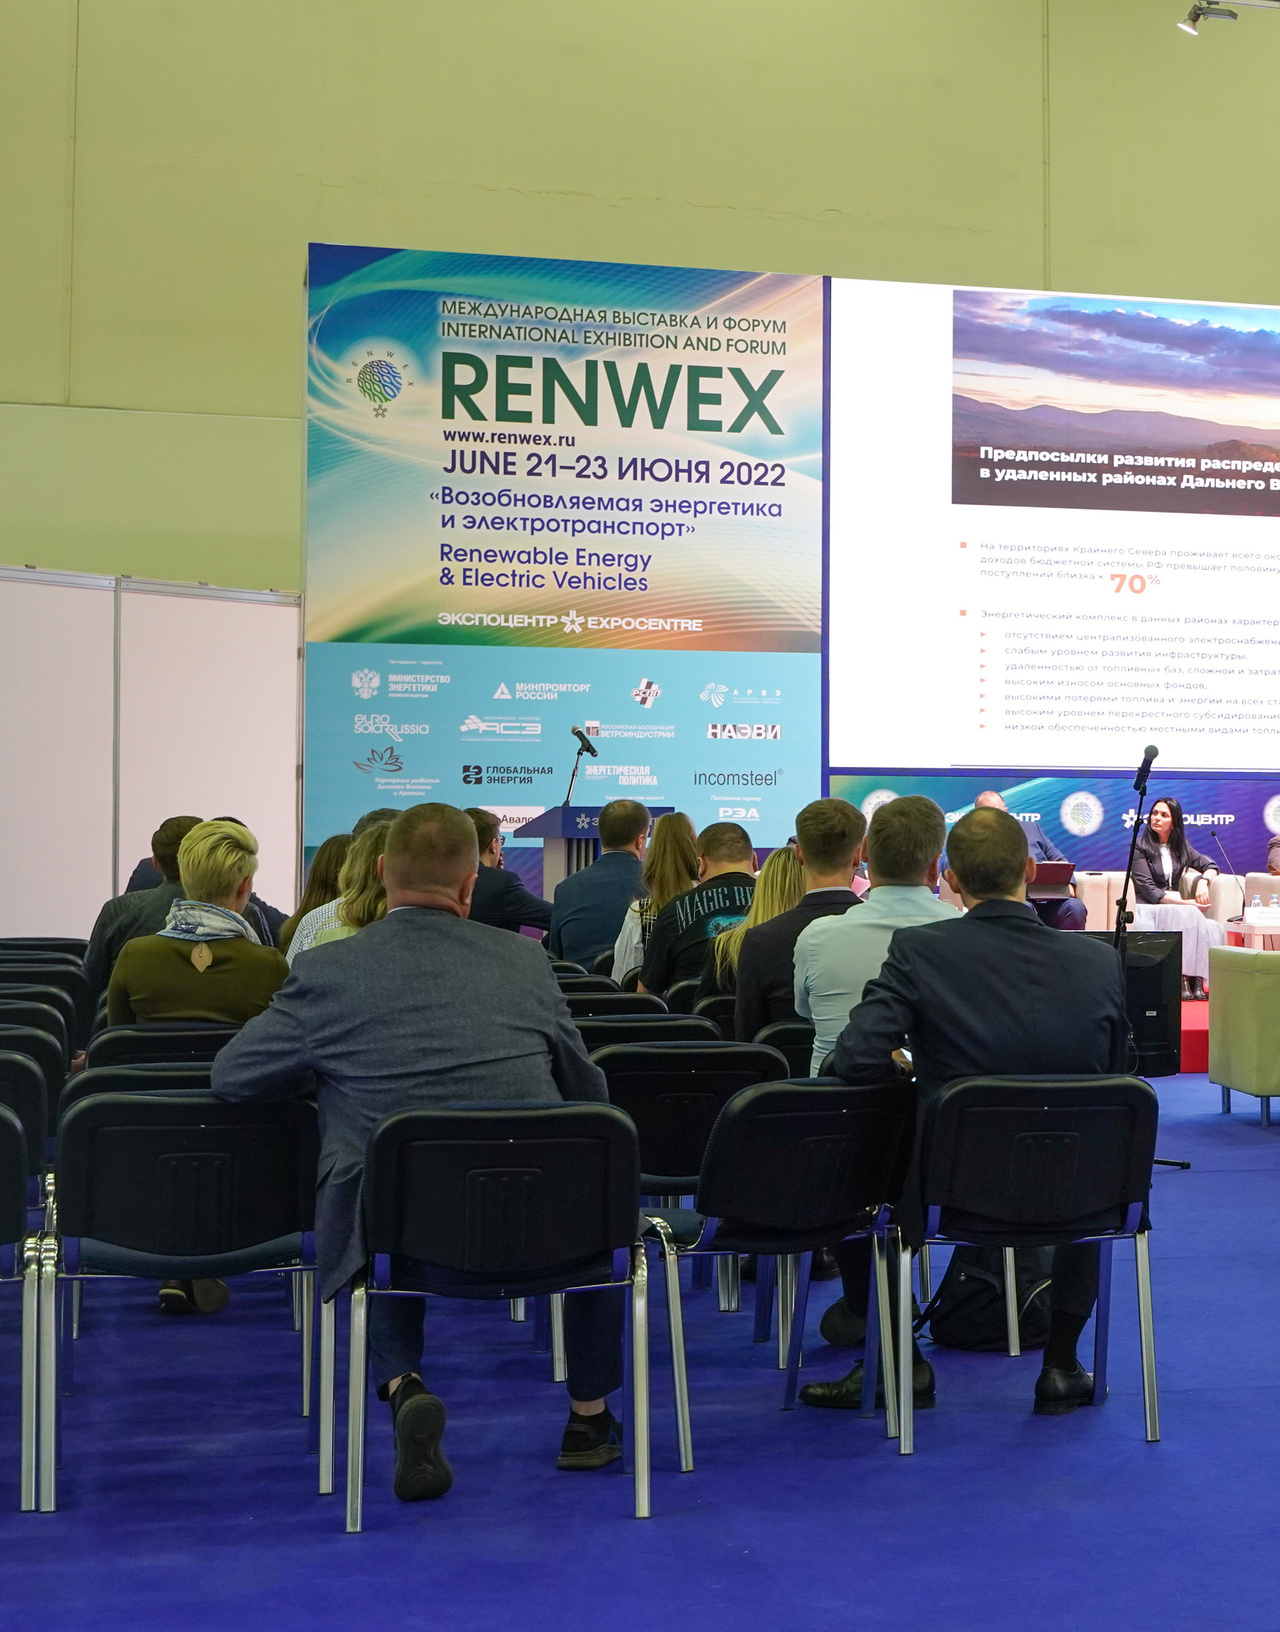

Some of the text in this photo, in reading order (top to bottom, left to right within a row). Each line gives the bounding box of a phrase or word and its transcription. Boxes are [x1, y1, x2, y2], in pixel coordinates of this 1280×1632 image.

[442, 300, 786, 334] МЕЖДУНАРОДНАЯ ВЫСТАВКА И ФОРУМ
[442, 322, 786, 355] INTERNATIONAL EXHIBITION AND FORUM
[441, 351, 785, 435] RENWEX
[442, 430, 576, 447] www.renwex.ru
[980, 446, 1108, 464] Предпосылки
[1113, 454, 1196, 470] развития
[442, 449, 517, 475] JUNE
[618, 457, 710, 483] ИЮНЯ
[719, 461, 786, 486] 2022
[980, 467, 991, 478] в
[994, 468, 1098, 482] удаленных
[1102, 471, 1177, 486] районах
[1180, 474, 1266, 489] Дальнего
[649, 499, 782, 517] энергетика
[441, 514, 455, 528] и
[440, 543, 652, 572] Renewable Energy
[998, 544, 1069, 552] территориях
[1073, 546, 1125, 554] Крайнего
[1128, 547, 1167, 556] Севера
[1170, 550, 1229, 558] проживает
[439, 567, 648, 591] & Electric Vehicles
[1110, 574, 1160, 594] 70%
[437, 612, 703, 632] ЭКСПОЦЕНТР EXPOCENTRE
[981, 610, 1073, 619] Энергетический
[1184, 616, 1228, 624] районах
[388, 674, 451, 683] МИНИСТЕРСТВО
[388, 683, 438, 692] ЭНЕРГЕТИКИ
[516, 682, 591, 693] МИНПРОМТОРГ
[516, 691, 558, 700] РОССИИ
[600, 730, 675, 739] ВЕТРОИНДУСТРИИ
[707, 723, 781, 739] НАЭВИ
[486, 765, 553, 775] ГЛОБАЛЬНАЯ
[585, 765, 650, 776] ЭНЕРГЕТИЧЕСКАЯ
[486, 776, 533, 784] ЭНЕРГИЯ
[618, 775, 658, 786] ПОЛИТИКА
[719, 807, 760, 818] РЭА
[676, 886, 730, 935] MAGIC
